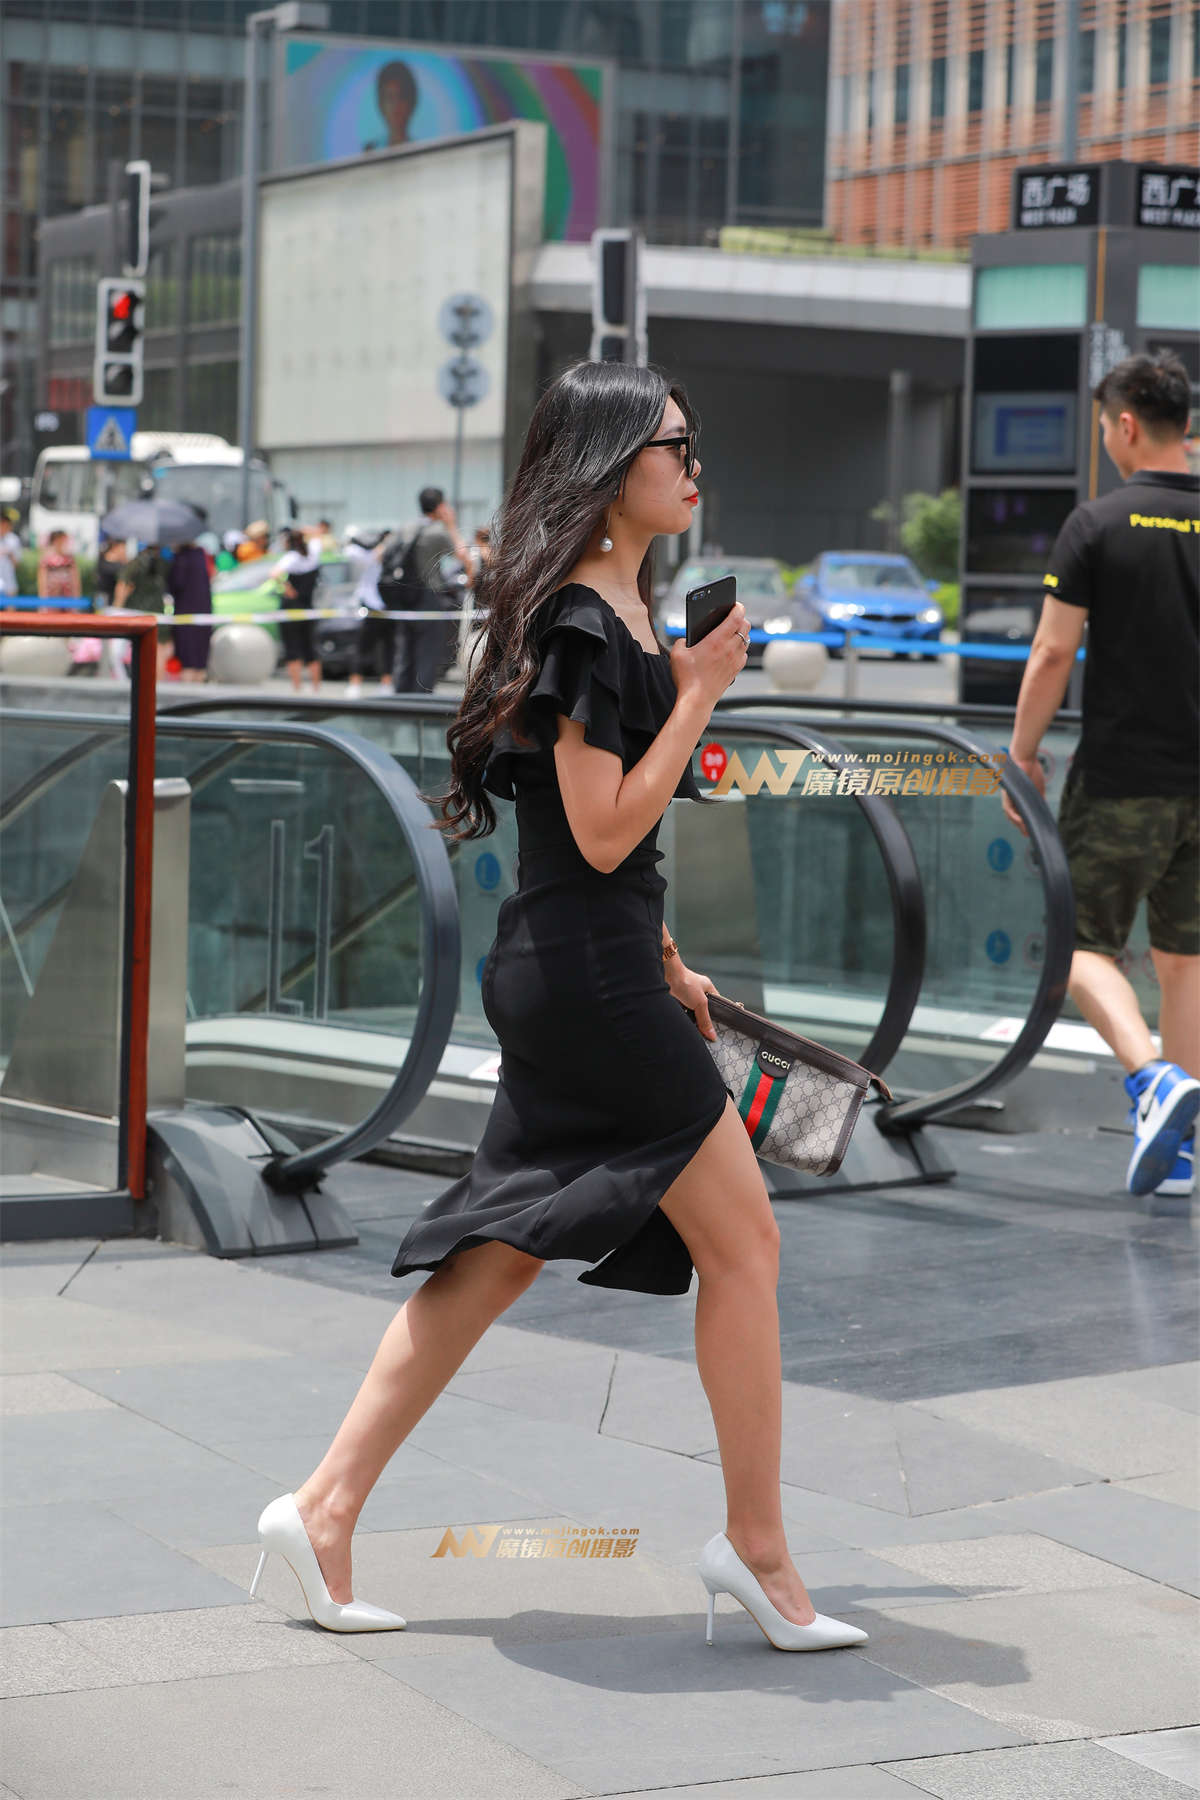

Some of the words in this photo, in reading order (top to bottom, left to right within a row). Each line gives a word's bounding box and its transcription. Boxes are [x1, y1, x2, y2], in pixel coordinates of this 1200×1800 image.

[1022, 173, 1091, 208] 西广场
[1142, 173, 1200, 207] 西广
[1130, 513, 1190, 533] Personal
[266, 819, 334, 1023] L1
[761, 1051, 791, 1070] GUCCI
